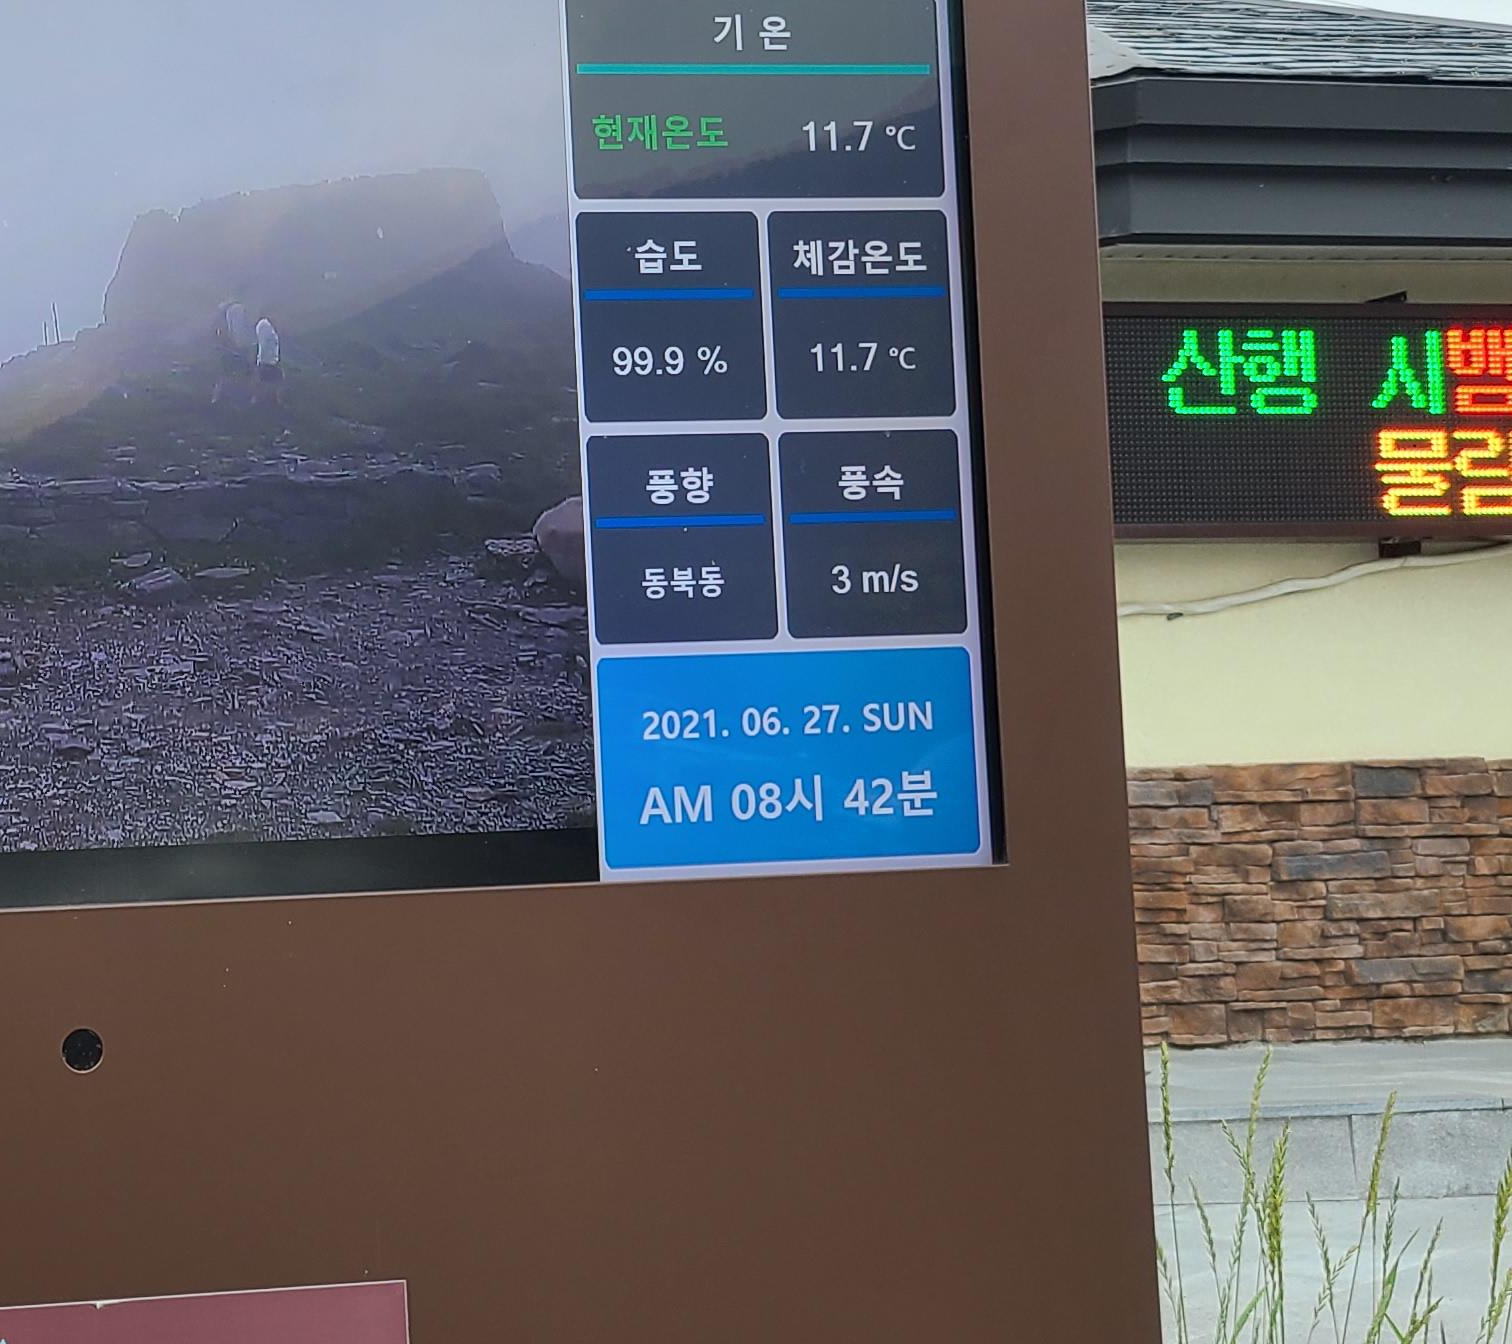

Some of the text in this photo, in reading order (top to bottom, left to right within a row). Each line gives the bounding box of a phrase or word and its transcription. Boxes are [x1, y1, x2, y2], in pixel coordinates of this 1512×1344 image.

[713, 14, 792, 51] 기 온
[592, 114, 729, 151] 현재온도
[802, 120, 874, 153] 11.7
[634, 239, 703, 275] 습도
[792, 239, 927, 276] 체감온도
[612, 345, 728, 376] 99.9 %
[810, 342, 878, 372] 11.7
[1161, 329, 1318, 415] 산행
[1371, 329, 1447, 415] 시
[645, 467, 714, 505] 풍향
[837, 464, 905, 501] 풍속
[641, 564, 725, 600] 동북동
[831, 564, 919, 595] 3 m/s
[642, 701, 933, 740] 2021. 06. 27. SUN
[639, 769, 938, 825] AM 08시 42분
